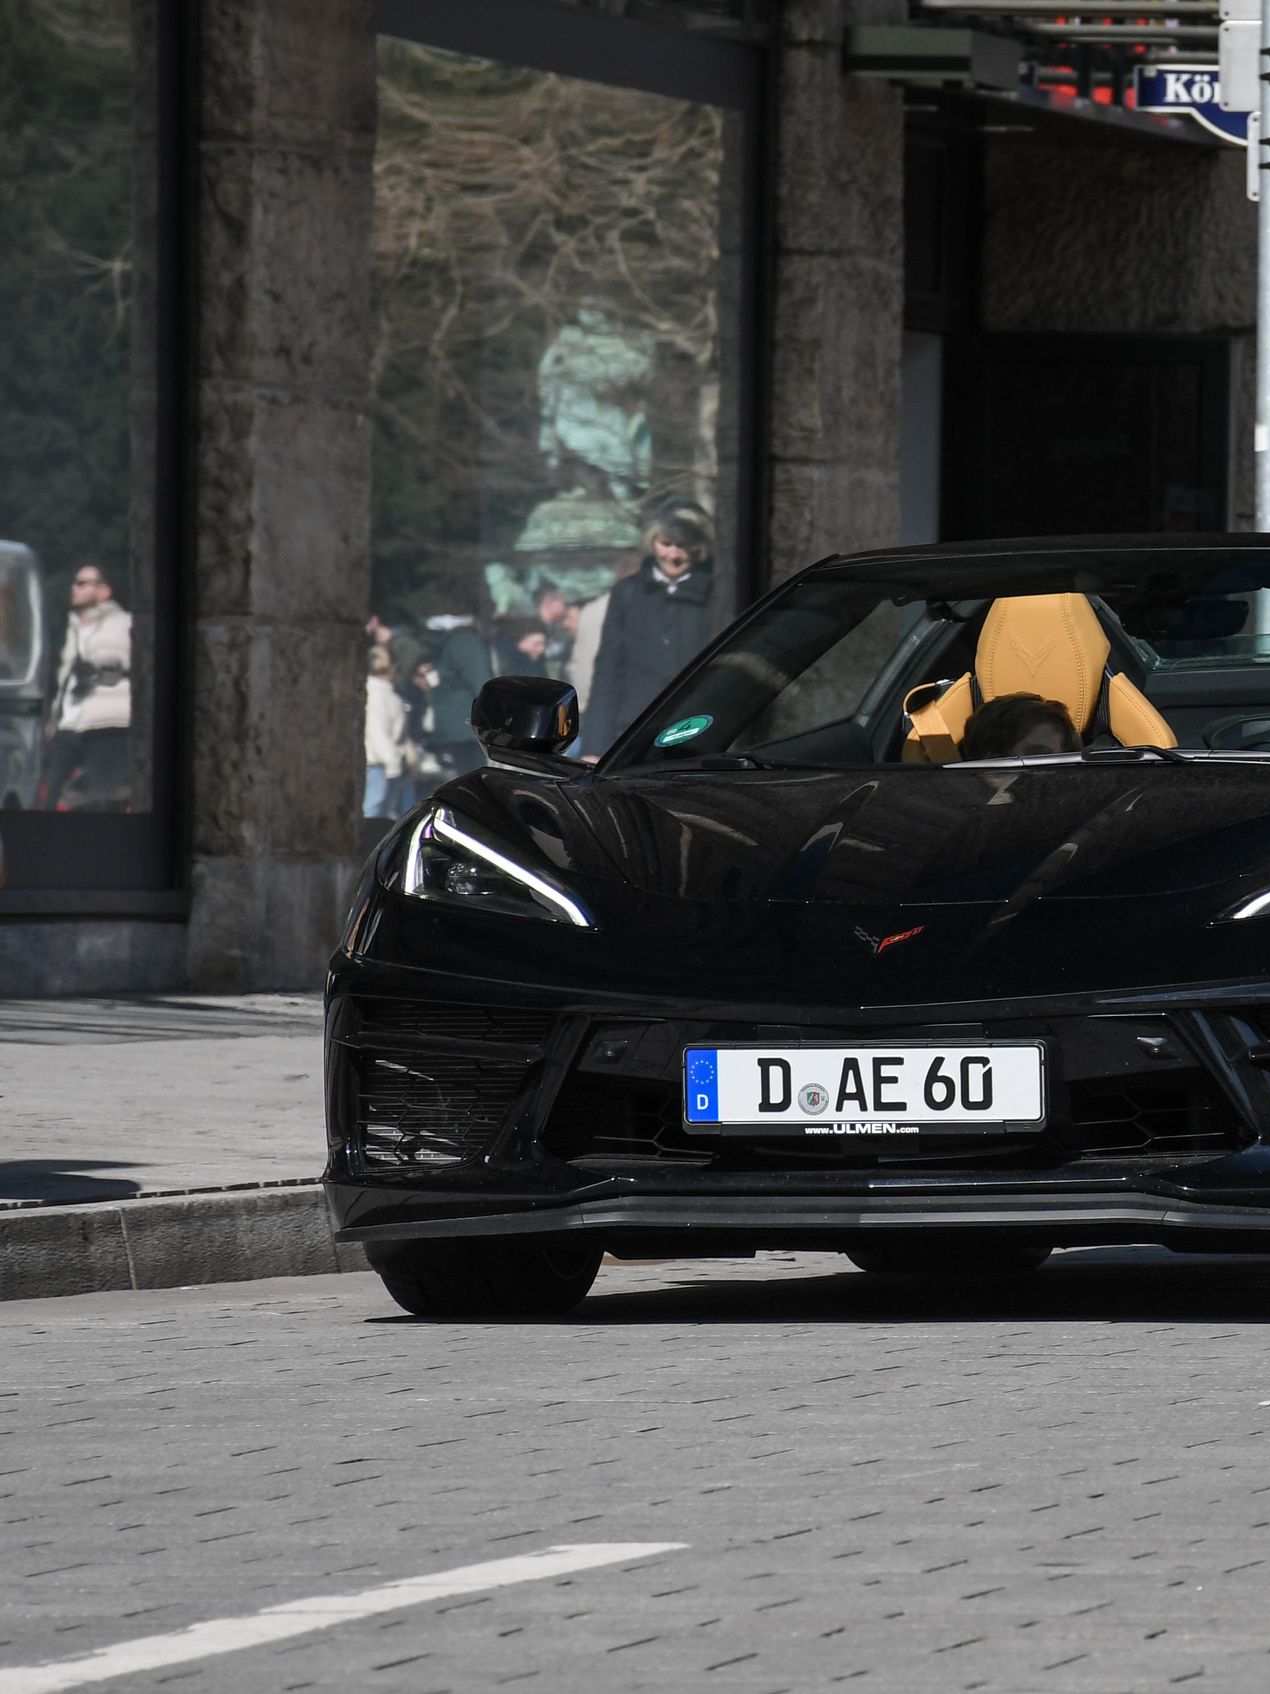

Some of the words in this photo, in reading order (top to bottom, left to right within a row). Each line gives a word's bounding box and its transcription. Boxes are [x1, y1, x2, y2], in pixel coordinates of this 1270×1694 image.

[757, 1057, 792, 1112] D
[835, 1056, 907, 1112] AE
[924, 1056, 993, 1111] 60
[697, 1094, 709, 1110] D
[804, 1123, 920, 1135] www.ULMEN.com
